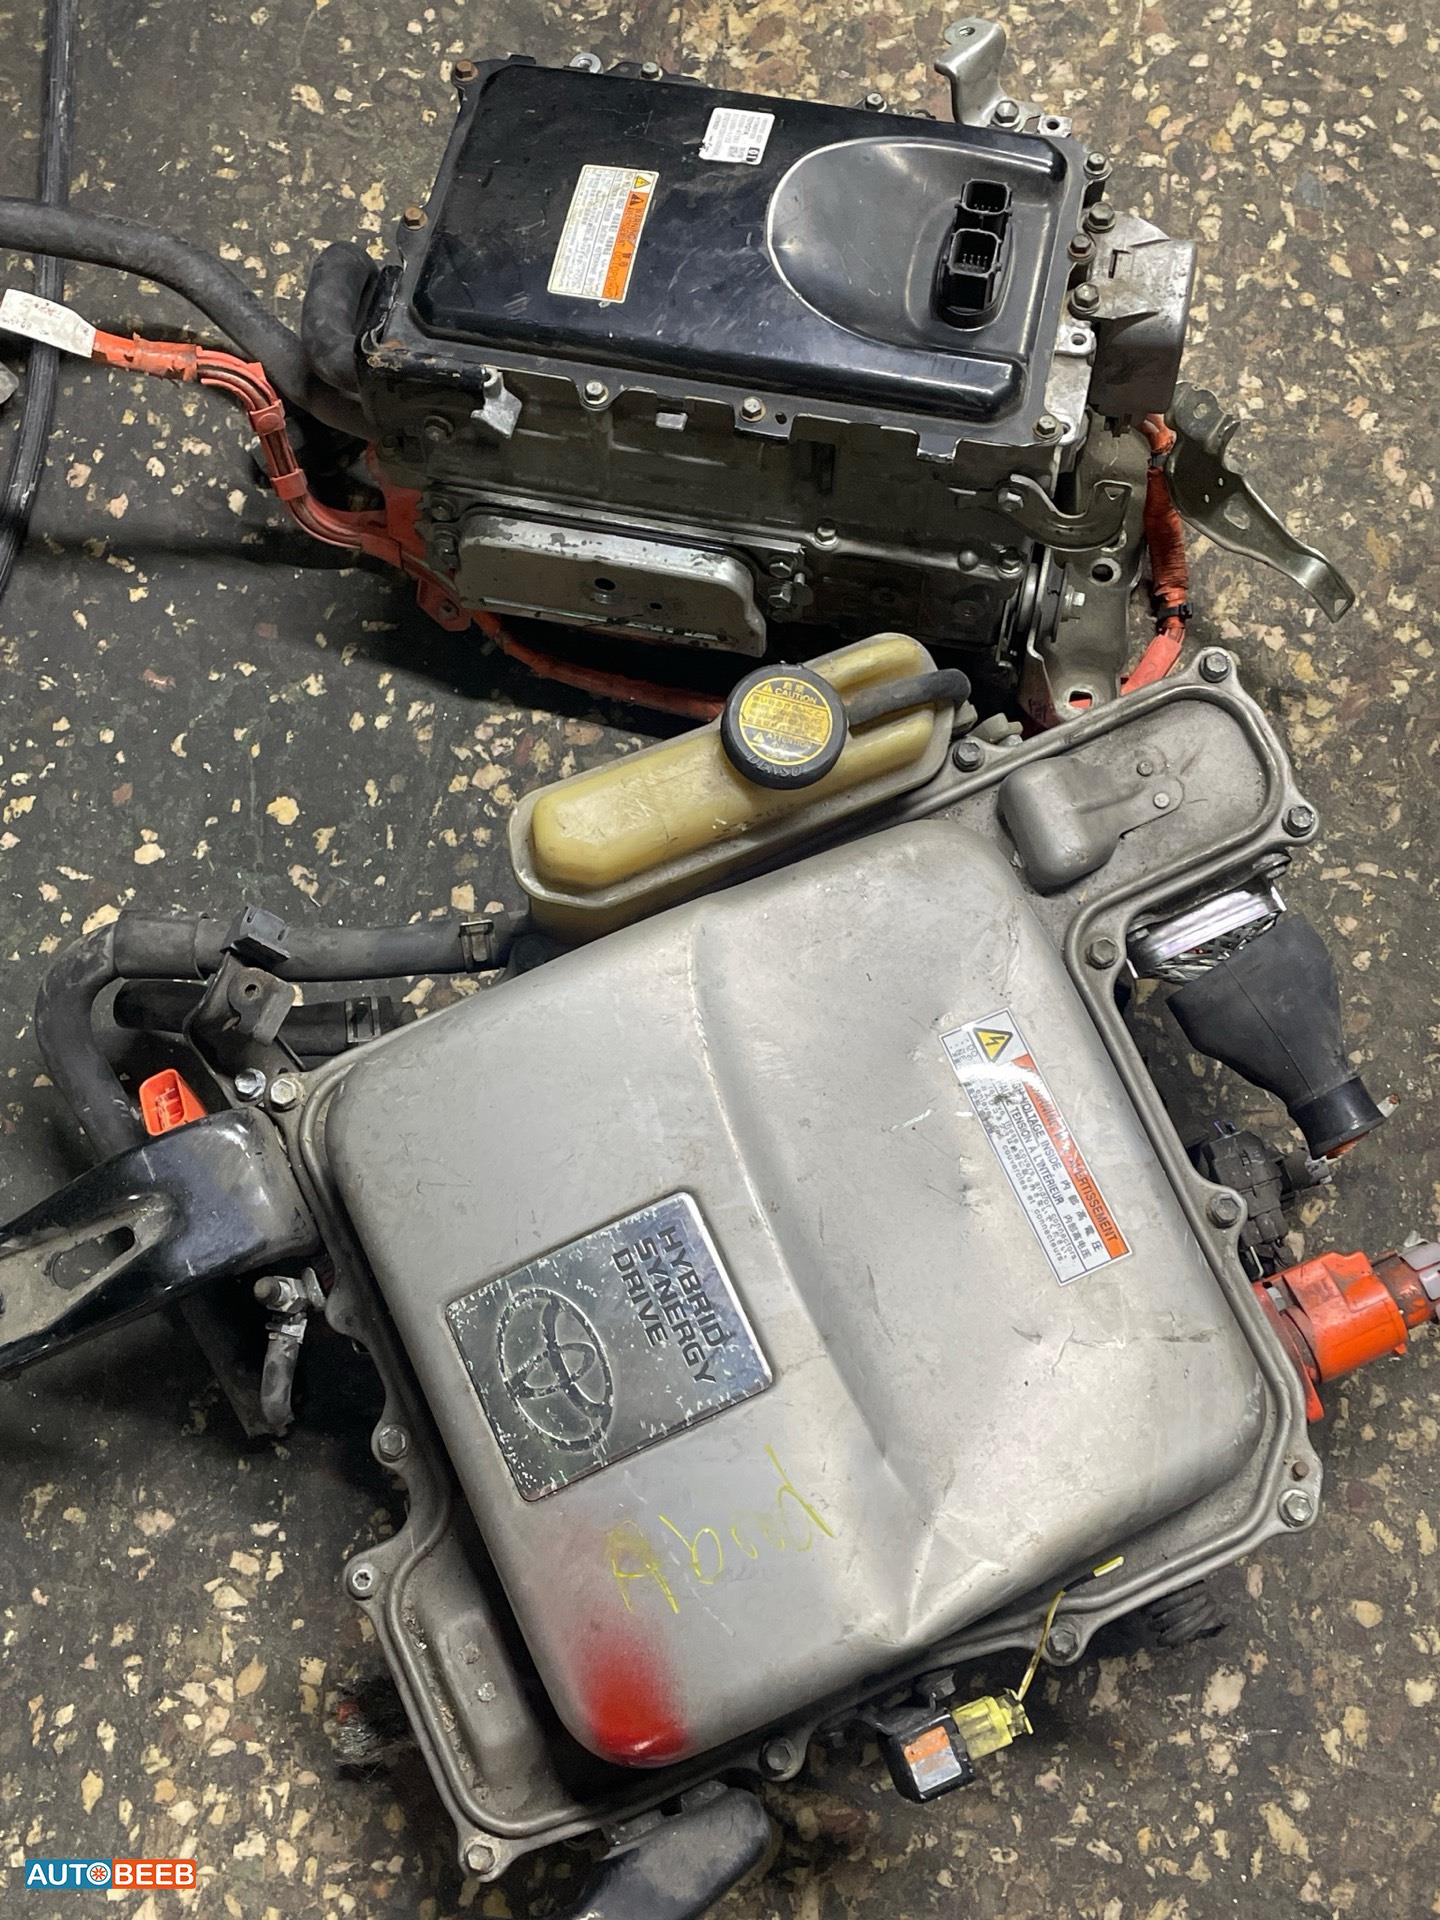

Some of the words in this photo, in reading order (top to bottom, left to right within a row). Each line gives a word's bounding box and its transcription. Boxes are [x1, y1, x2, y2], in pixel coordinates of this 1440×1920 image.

[774, 688, 817, 704] CAUTION
[746, 753, 803, 777] DENSO
[765, 732, 815, 750] ATTENTION
[1008, 1105, 1034, 1143] TENSION
[1017, 1096, 1045, 1138] VOLTAGE
[1039, 1139, 1062, 1171] INSIDE
[612, 1247, 668, 1347] DRIVE
[633, 1239, 718, 1385] SYNERGY
[657, 1226, 725, 1348] HYBRID
